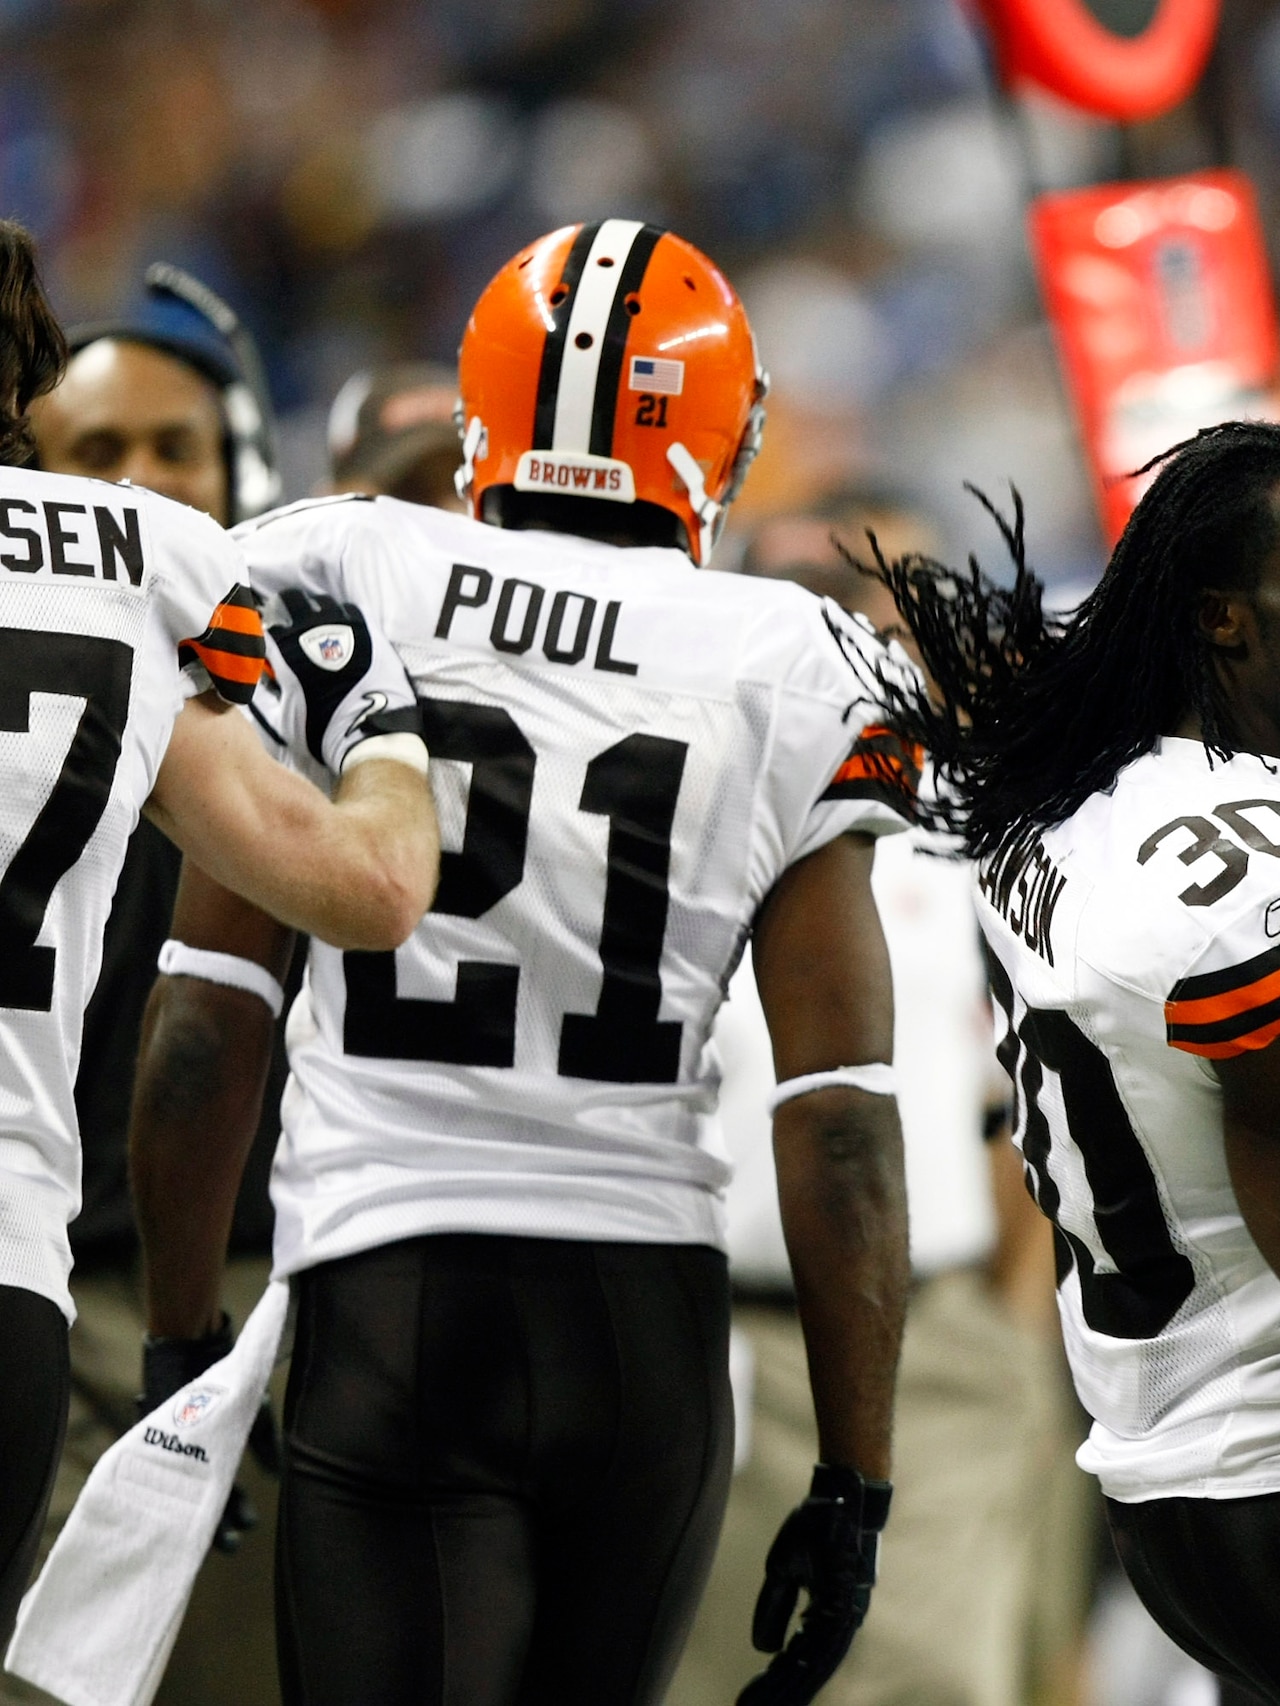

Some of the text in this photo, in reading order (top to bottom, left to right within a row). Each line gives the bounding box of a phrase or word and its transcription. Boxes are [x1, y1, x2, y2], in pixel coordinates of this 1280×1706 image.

[635, 394, 669, 429] 21
[529, 459, 622, 491] BROWNS
[434, 564, 639, 676] POOL
[343, 698, 690, 1084] 21
[143, 1425, 210, 1463] Wilson
